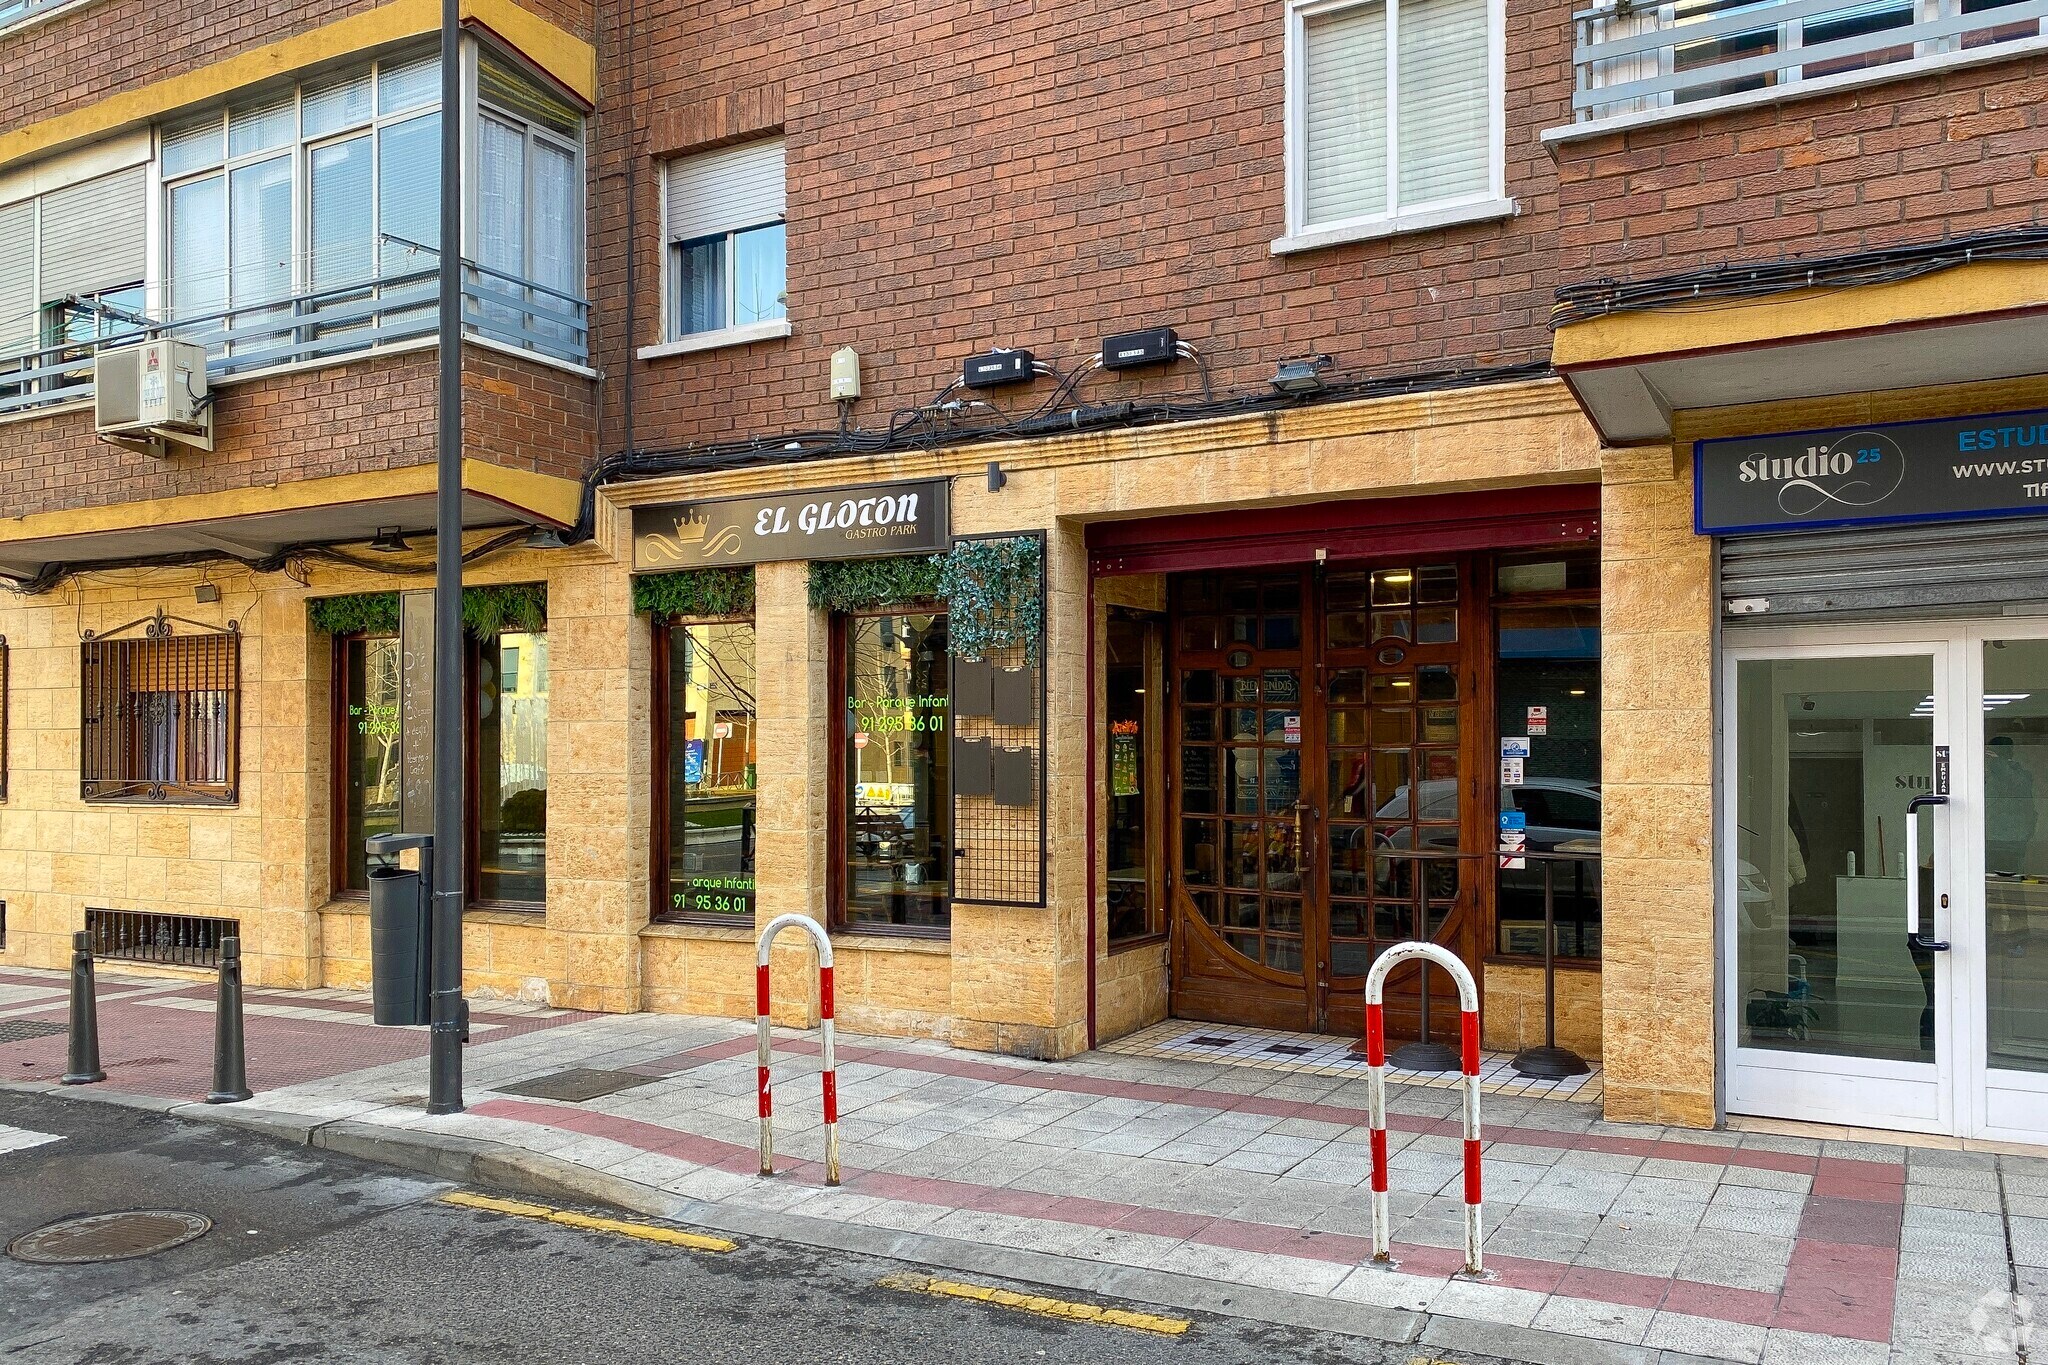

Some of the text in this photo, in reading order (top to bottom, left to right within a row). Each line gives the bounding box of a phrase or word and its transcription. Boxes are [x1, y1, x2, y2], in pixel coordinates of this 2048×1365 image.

[1739, 446, 1881, 482] studio 25
[1952, 458, 2048, 479] WWW.ST
[754, 493, 919, 536] EL GLOTON
[845, 523, 917, 540] GASTRO PARK
[1240, 680, 1292, 691] BIENENIDOS
[349, 704, 363, 716] Bar
[847, 696, 866, 709] Bar
[876, 695, 916, 712] Parque
[358, 721, 368, 735] 91
[861, 716, 874, 732] 91
[877, 716, 904, 732] 295
[929, 715, 943, 731] 01
[687, 878, 722, 890] arque
[673, 894, 686, 909] 91
[714, 896, 731, 911] 36
[733, 897, 746, 912] 01
